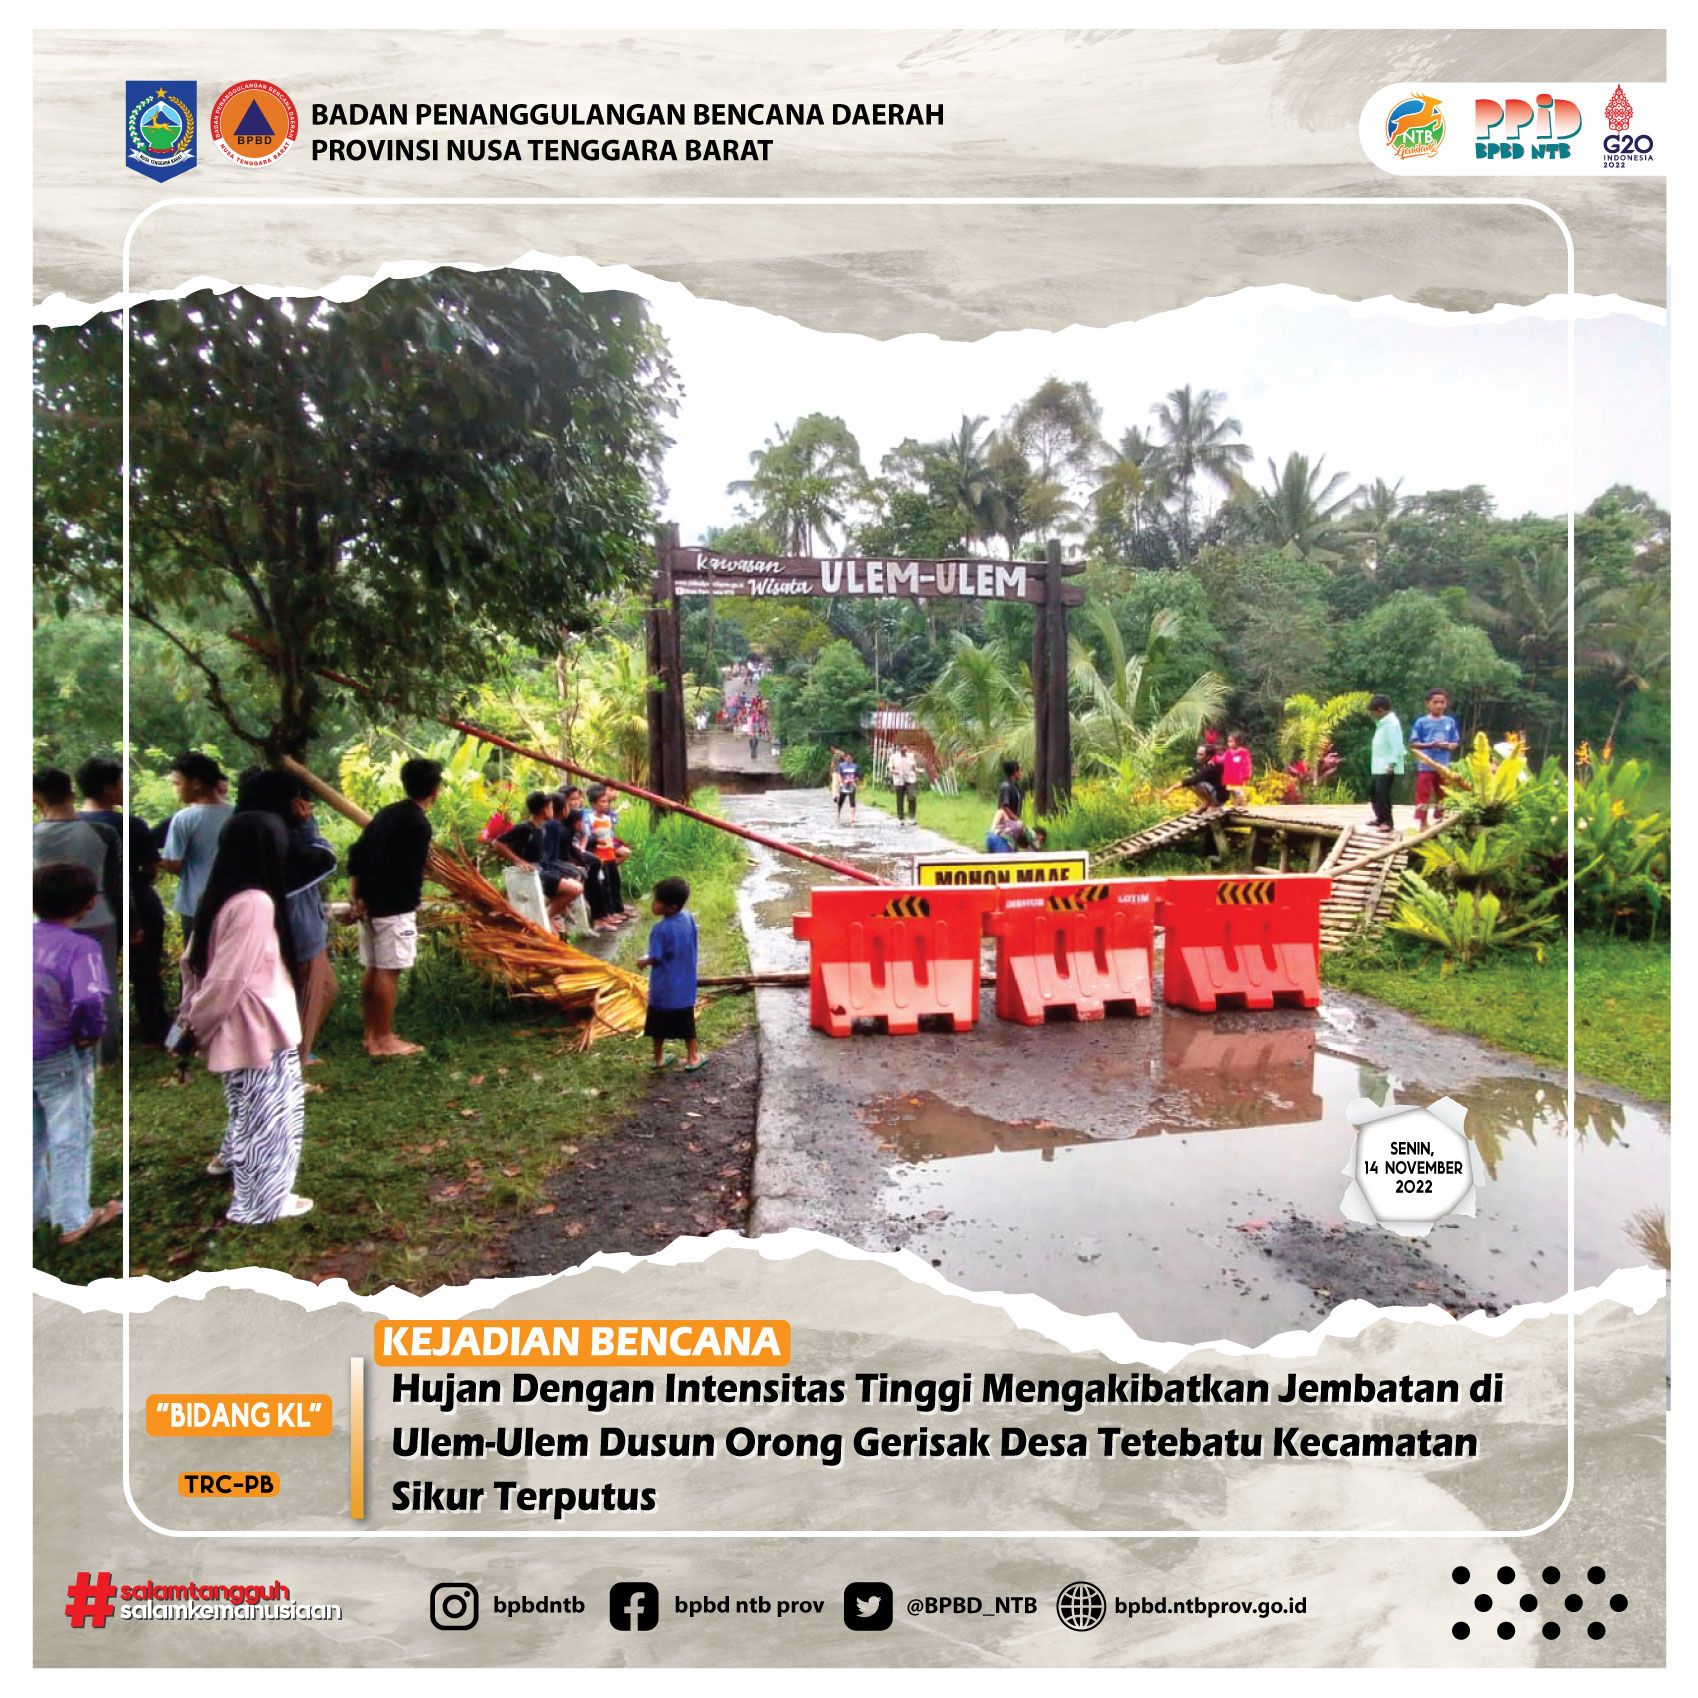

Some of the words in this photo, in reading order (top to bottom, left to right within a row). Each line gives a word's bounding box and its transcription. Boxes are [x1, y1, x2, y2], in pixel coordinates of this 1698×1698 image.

[747, 577, 813, 596] Wisata
[820, 560, 1028, 599] ULEM-ULEM
[935, 869, 1010, 886] MOHON
